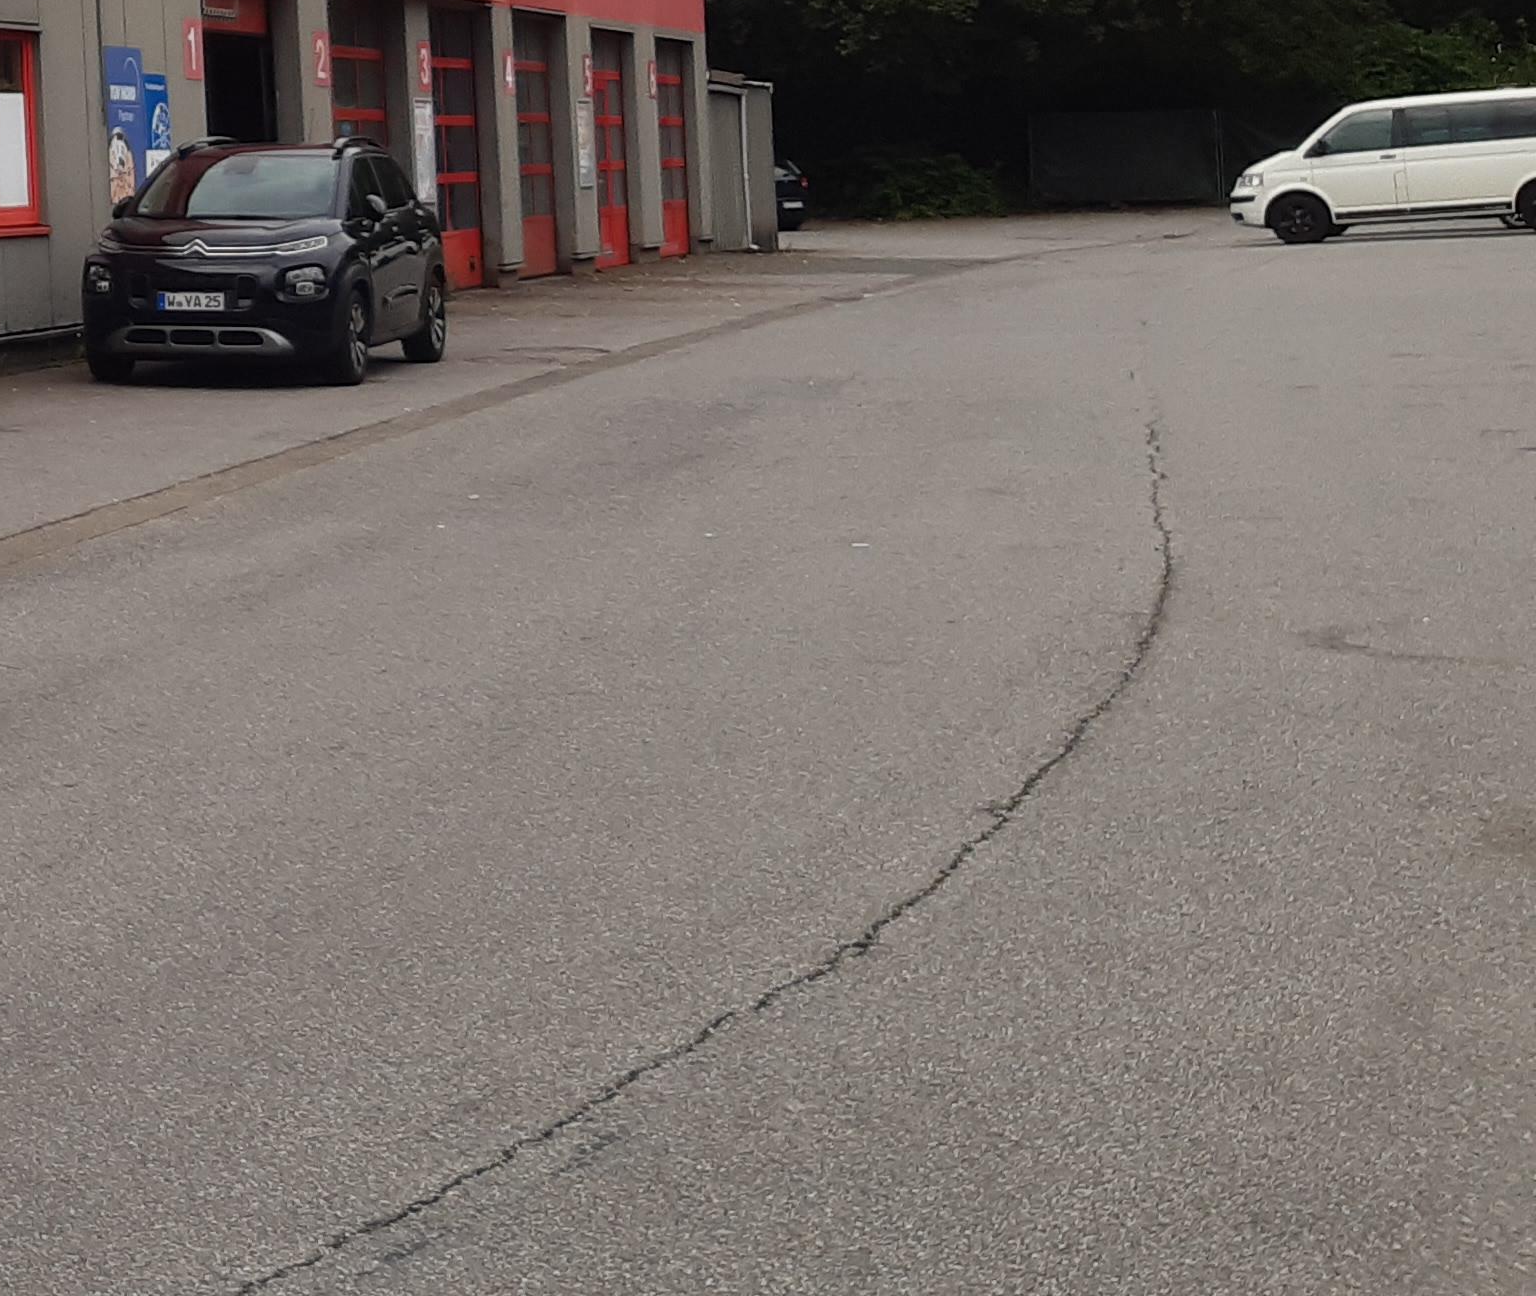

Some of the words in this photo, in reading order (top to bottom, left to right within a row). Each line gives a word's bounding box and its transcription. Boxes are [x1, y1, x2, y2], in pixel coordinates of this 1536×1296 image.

[187, 27, 197, 70] 1
[315, 39, 328, 79] 2
[420, 48, 429, 85] 3
